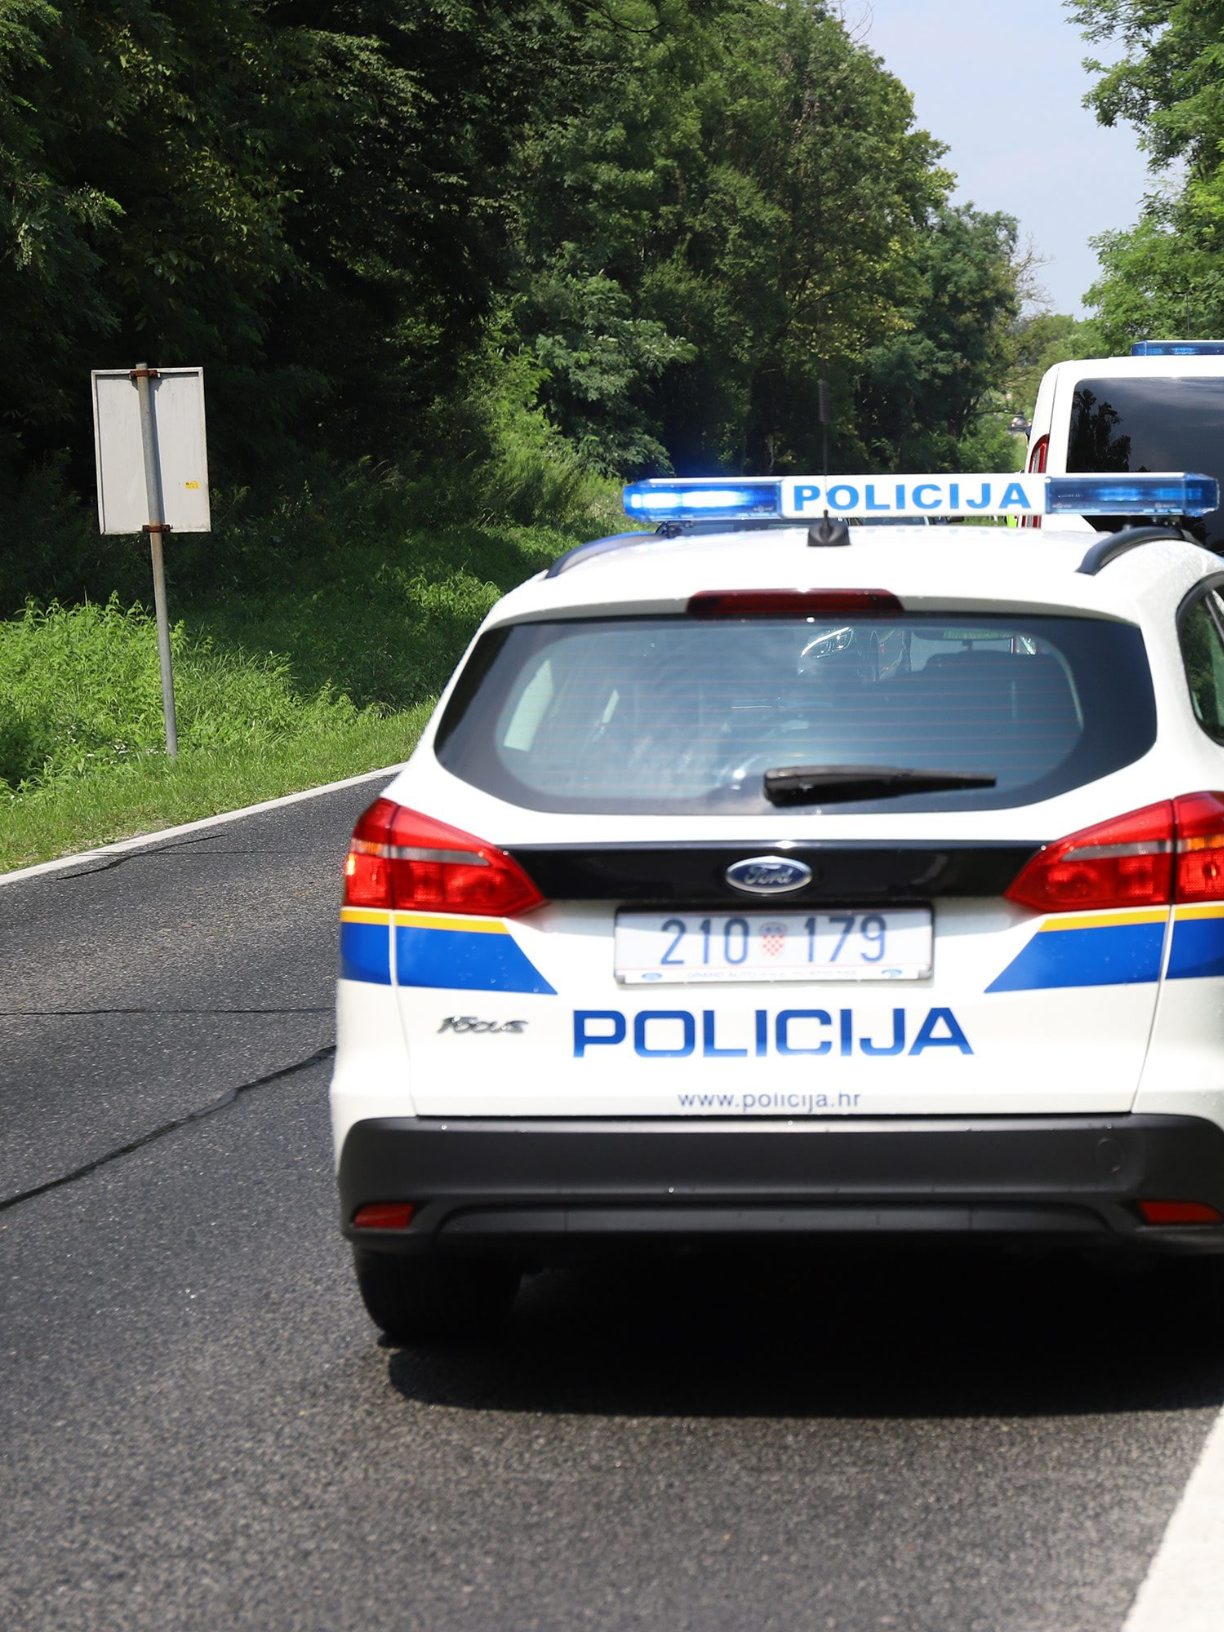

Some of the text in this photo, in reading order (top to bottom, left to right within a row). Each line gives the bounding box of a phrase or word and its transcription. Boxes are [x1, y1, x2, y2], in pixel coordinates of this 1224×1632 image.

[793, 484, 1032, 511] POLICIJA
[743, 864, 793, 885] Ford
[660, 914, 886, 965] 210 179
[573, 1007, 974, 1057] POLICIJA
[678, 1090, 861, 1114] www.policija.hr
